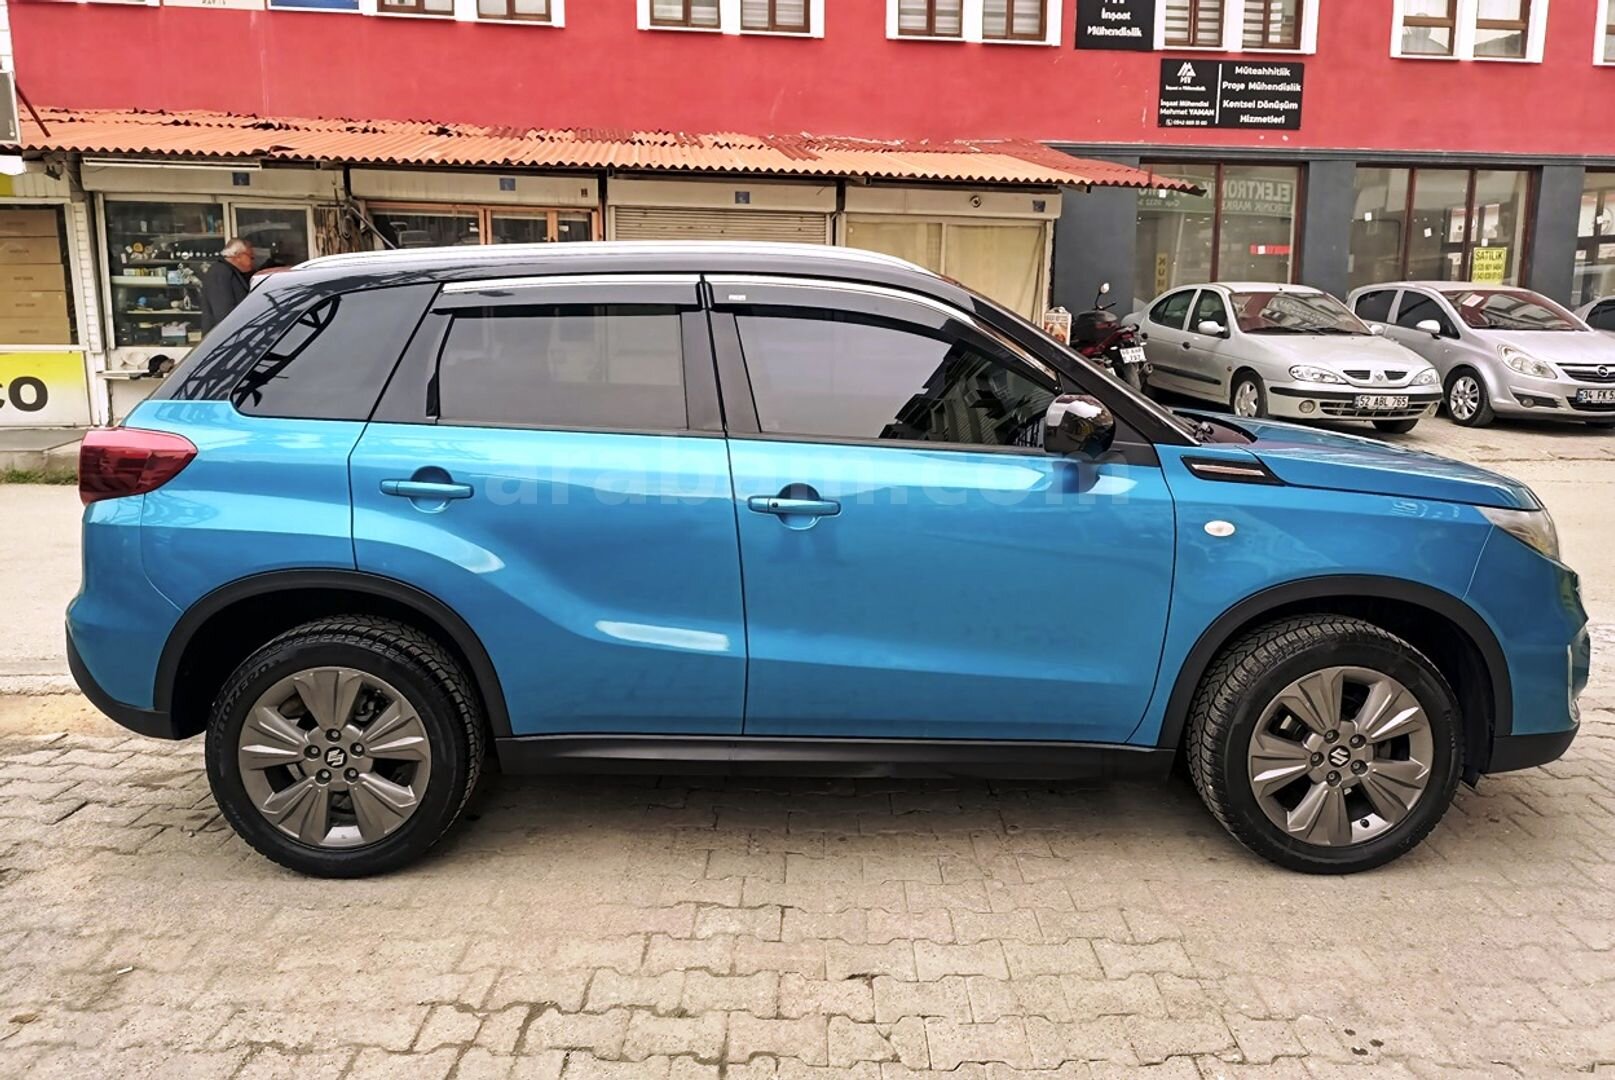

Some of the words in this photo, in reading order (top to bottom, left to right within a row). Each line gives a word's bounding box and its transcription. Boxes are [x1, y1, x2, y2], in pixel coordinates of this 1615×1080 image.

[1101, 7, 1131, 21] İnşaat
[1087, 25, 1142, 37] Mühendislik
[1235, 65, 1291, 76] Müteahhitlik
[1222, 81, 1246, 92] Proje
[1248, 82, 1302, 92] Mühendislik
[1222, 100, 1256, 108] Kentsel
[1257, 100, 1299, 111] Dönüşüm
[1239, 114, 1286, 124] Hizmetleri
[1360, 395, 1371, 406] 52
